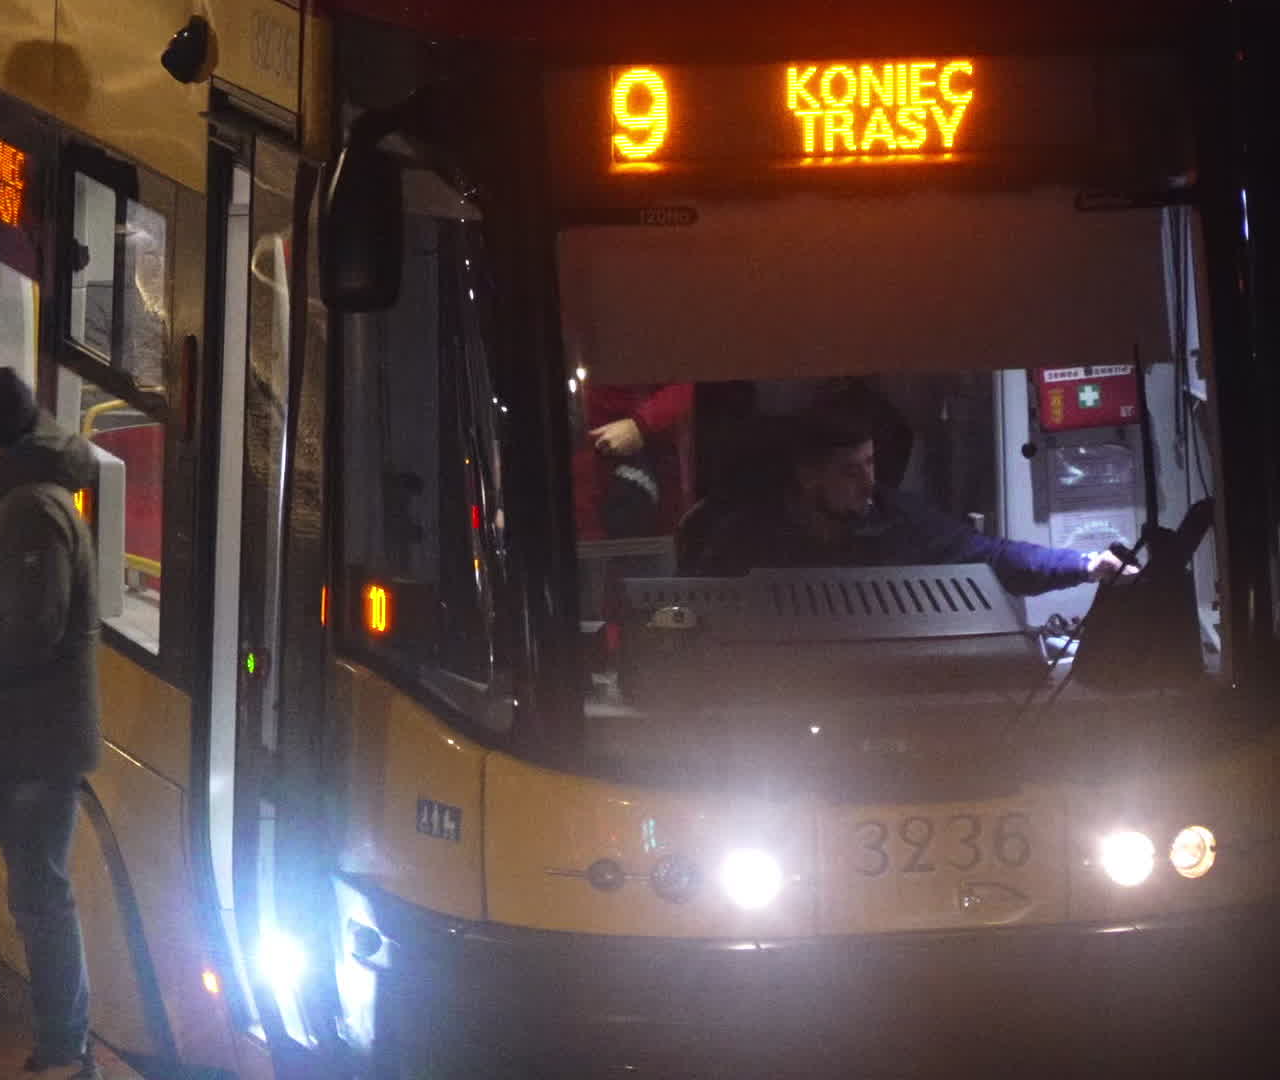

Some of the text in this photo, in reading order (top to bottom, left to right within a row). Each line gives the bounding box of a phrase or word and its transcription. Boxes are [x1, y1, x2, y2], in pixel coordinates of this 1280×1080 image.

[612, 68, 669, 159] 9
[786, 61, 974, 110] KONIEC
[794, 104, 966, 152] TRASY
[854, 812, 1032, 877] 3236
